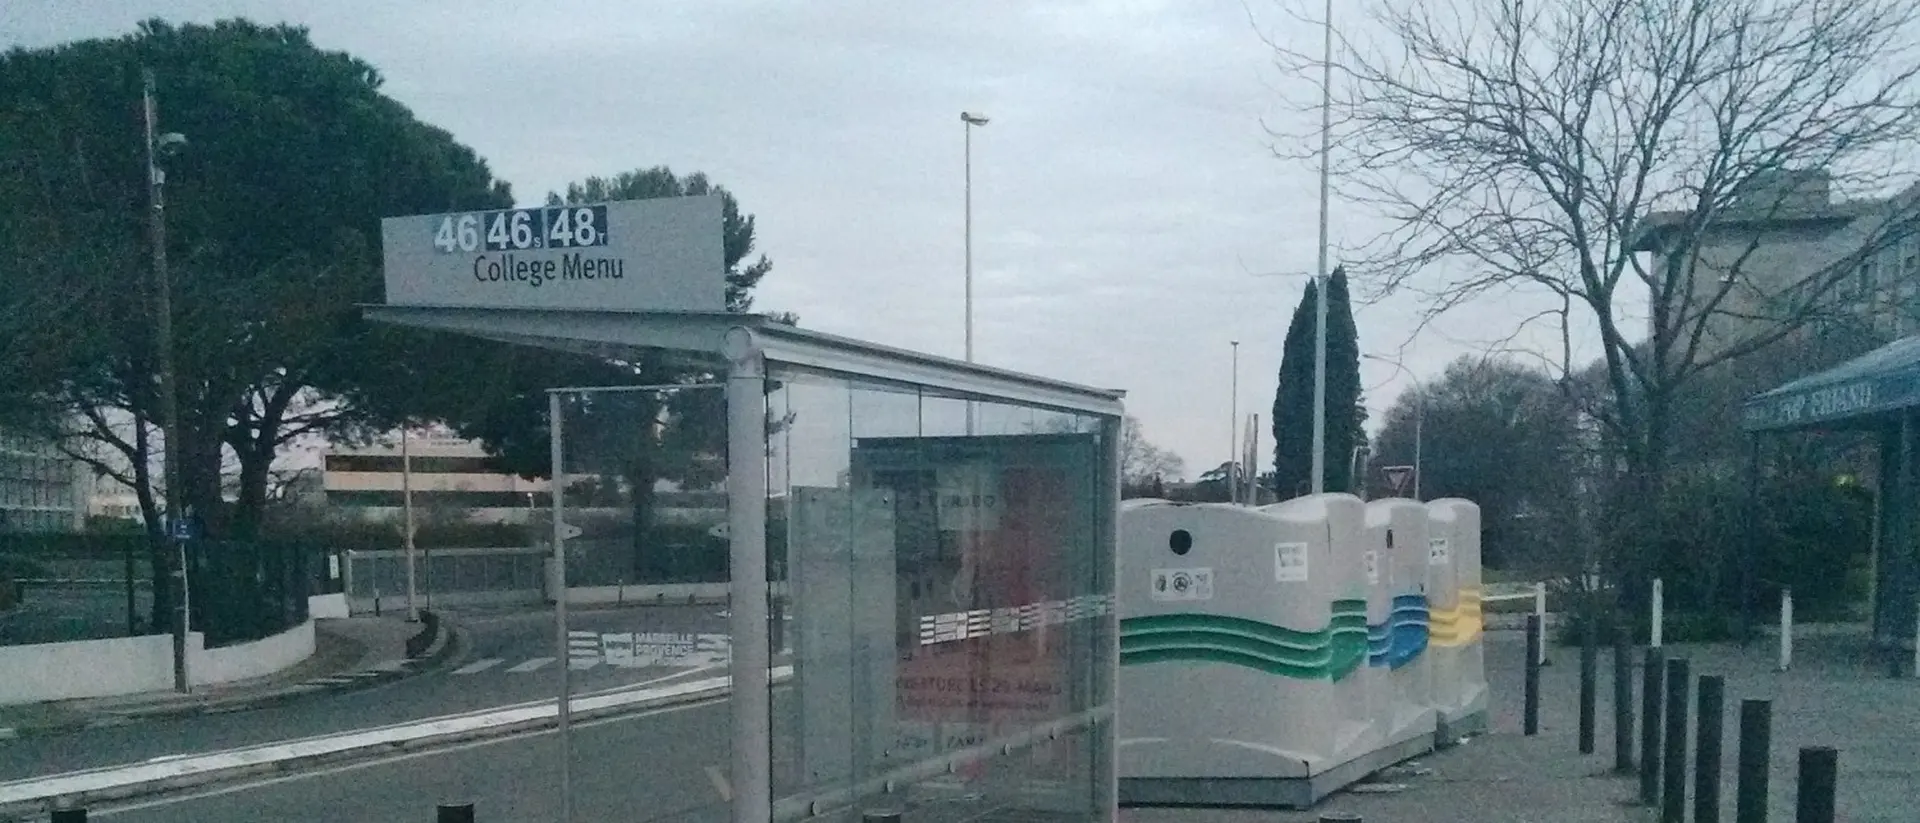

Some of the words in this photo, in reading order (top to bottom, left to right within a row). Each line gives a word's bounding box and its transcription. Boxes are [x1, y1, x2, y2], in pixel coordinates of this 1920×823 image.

[434, 214, 478, 252] 46
[473, 253, 556, 287] College
[563, 253, 623, 280] Menu
[635, 632, 694, 644] MARSEILLE
[635, 644, 694, 657] PROVENCE
